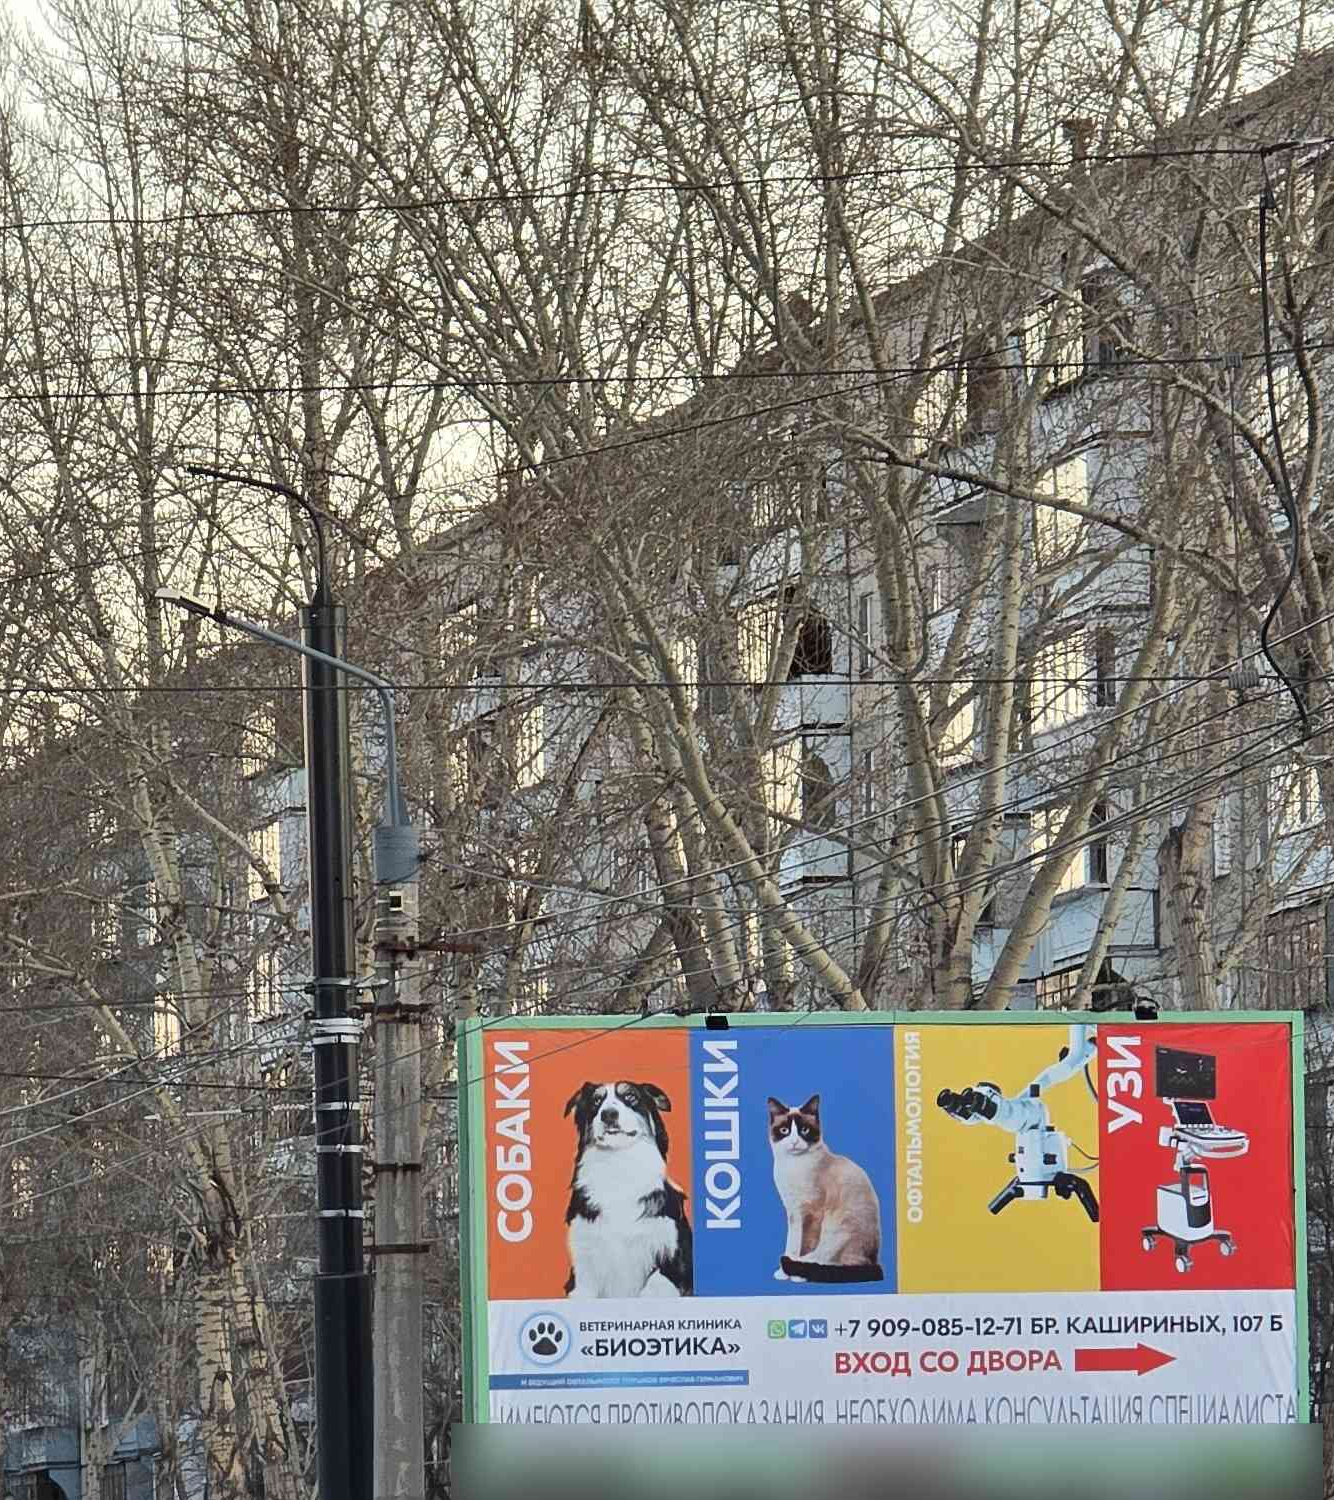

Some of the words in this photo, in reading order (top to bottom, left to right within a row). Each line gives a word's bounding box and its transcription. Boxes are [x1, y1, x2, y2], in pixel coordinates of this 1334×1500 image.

[1106, 1036, 1143, 1133] УЗИ
[494, 1041, 533, 1242] СОБАКИ
[702, 1040, 741, 1229] КОШКИ
[904, 1031, 923, 1223] ОФТАЛЬМОЛОГИЯ
[579, 1319, 675, 1332] ВЕТЕРИНАРНАЯ
[677, 1319, 742, 1331] КЛИНИКА
[580, 1337, 742, 1357] «БИОЭТИКА»
[835, 1319, 861, 1338] +7
[867, 1317, 1022, 1337] 909-085-12-71
[1030, 1317, 1060, 1335] БР.
[1066, 1315, 1227, 1337] КАШИРИНЫХ,
[1233, 1315, 1263, 1333] 107
[1270, 1315, 1283, 1333] Б
[834, 1351, 912, 1377] ВХОД
[919, 1350, 959, 1373] СО
[966, 1350, 1062, 1376] ДВОРА
